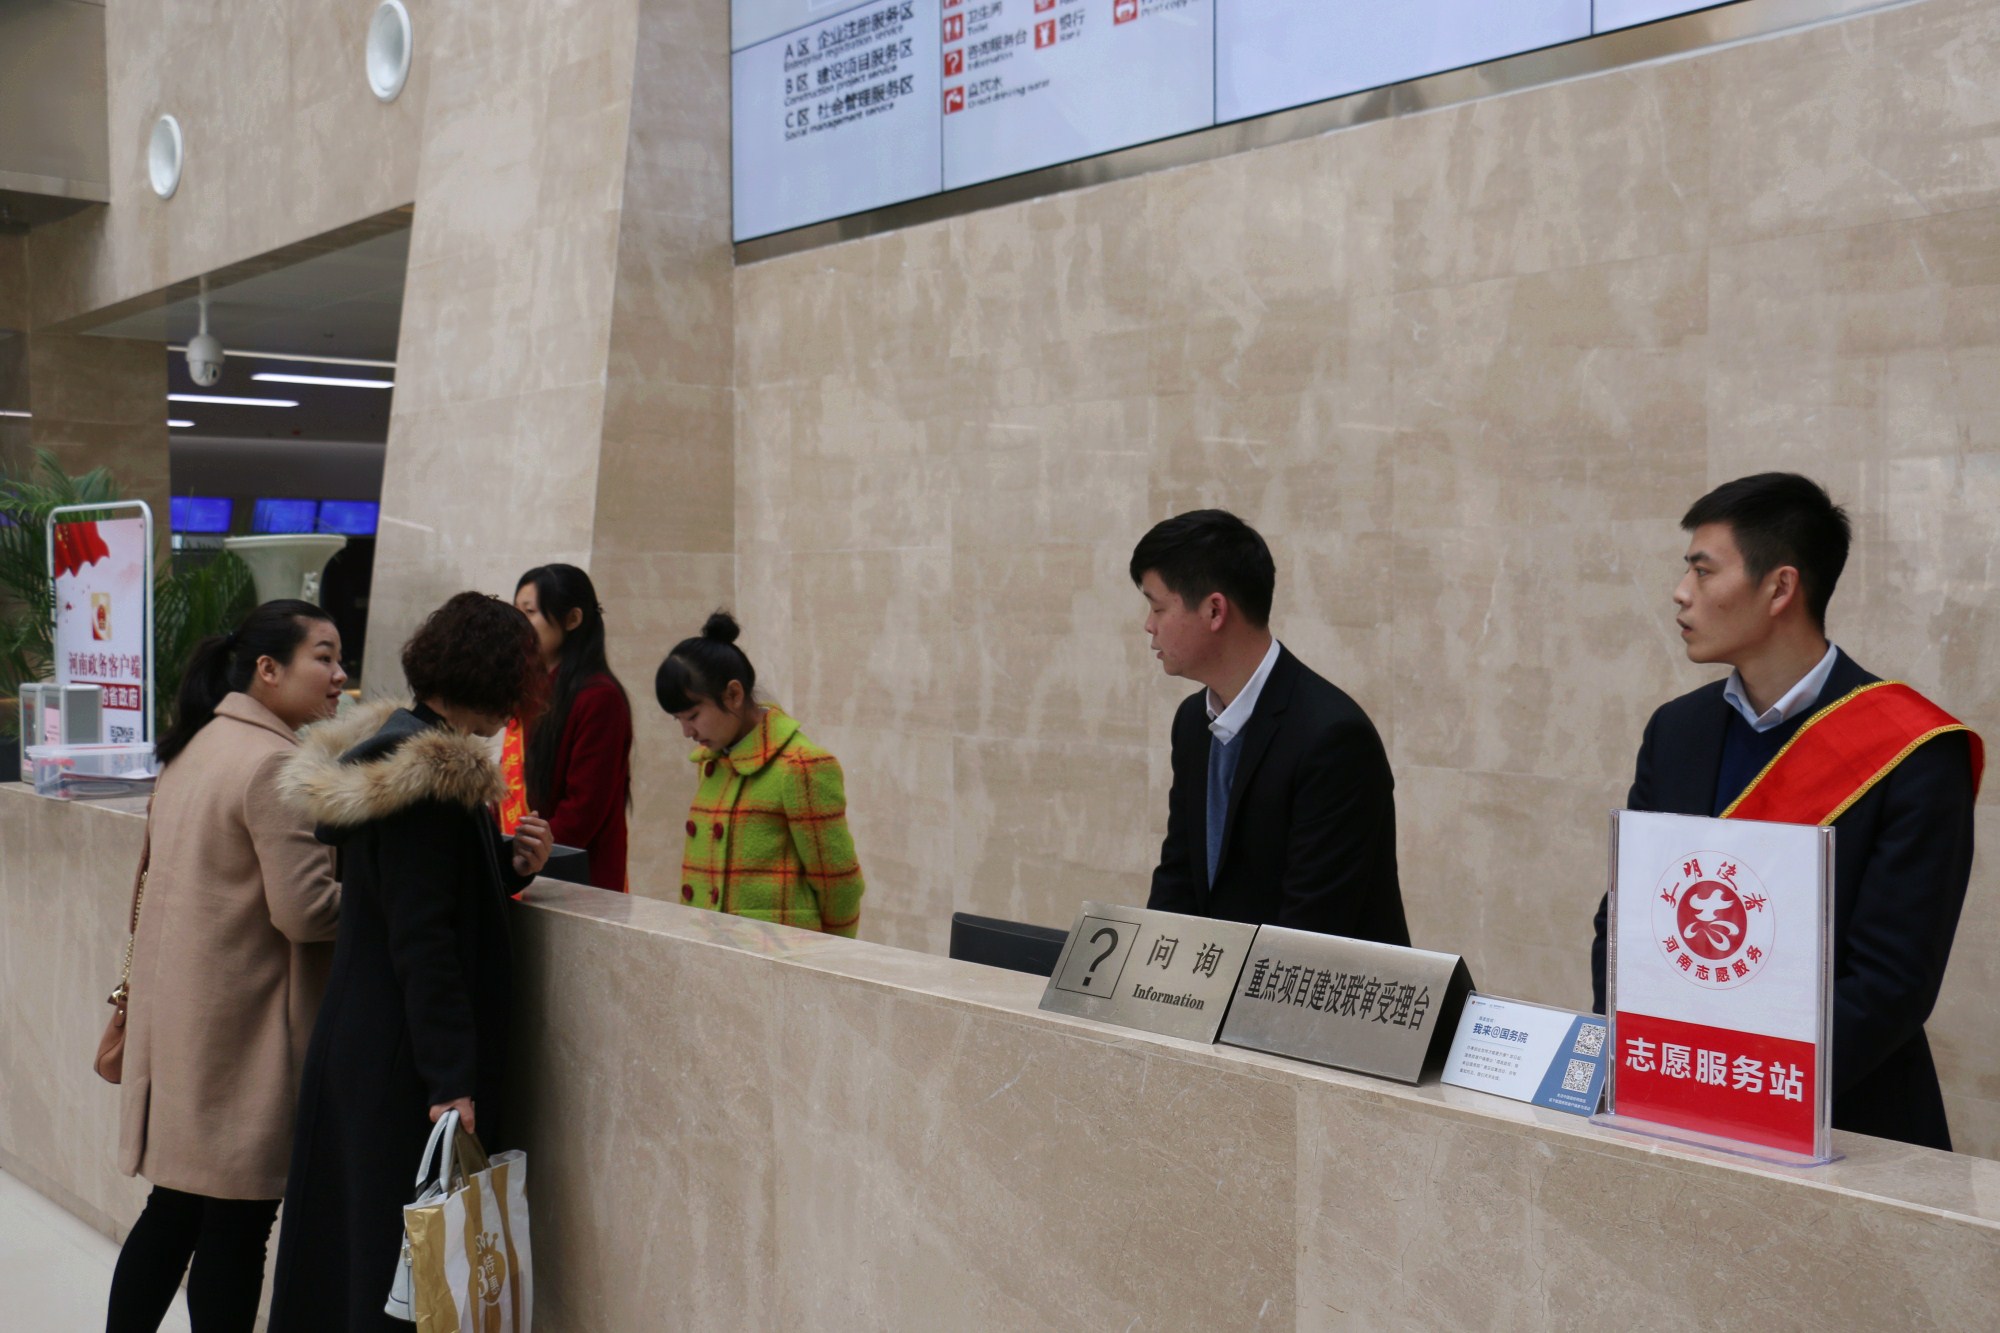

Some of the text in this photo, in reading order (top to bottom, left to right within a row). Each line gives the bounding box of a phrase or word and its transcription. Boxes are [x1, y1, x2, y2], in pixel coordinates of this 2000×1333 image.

[817, 1, 913, 50] 企业注册服务区
[968, 1, 1002, 23] 卫生间
[1060, 8, 1085, 29] 银行
[817, 38, 913, 84] 建设项目服务区
[836, 74, 866, 92] project
[869, 64, 897, 79] service
[810, 111, 862, 131] management
[866, 102, 894, 116] service
[817, 75, 913, 119] 社会管理服务区
[68, 650, 141, 679] 河南政务客户端
[1660, 858, 1767, 913] 文明使者
[1146, 933, 1225, 979] 问询
[1661, 936, 1763, 982] 河南志愿服务
[1132, 982, 1205, 1011] Information
[1244, 957, 1430, 1032] 重点项目建设联审受理台
[1472, 1022, 1529, 1044] 我来@国务院
[1625, 1037, 1804, 1102] 志愿服务站
